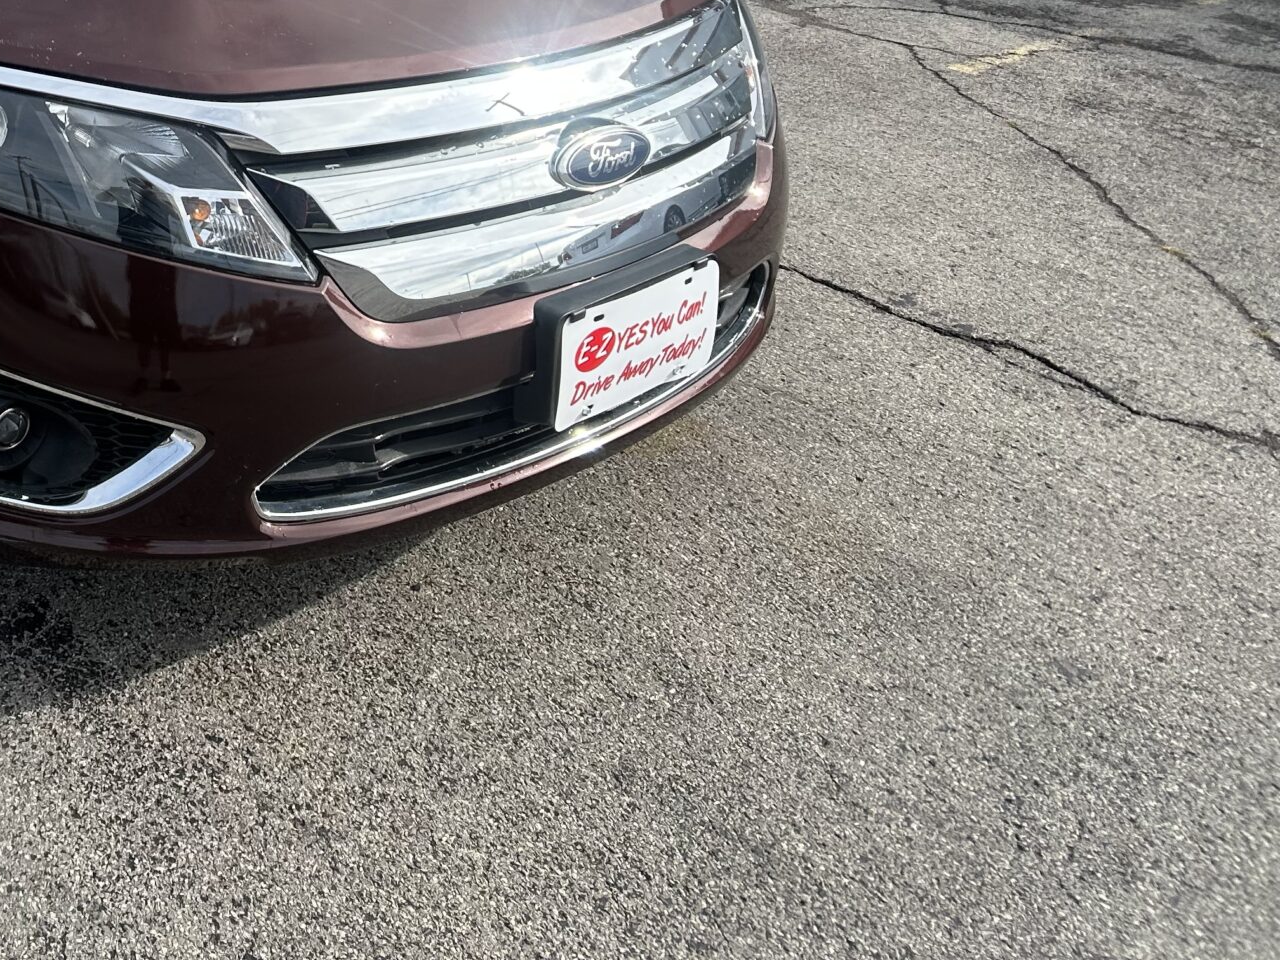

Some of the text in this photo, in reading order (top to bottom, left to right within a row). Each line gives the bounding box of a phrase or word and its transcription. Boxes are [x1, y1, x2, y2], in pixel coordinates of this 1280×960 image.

[588, 138, 639, 179] Ford
[577, 291, 707, 365] E-Z YES You Can!
[570, 327, 707, 406] Drive Away Today!
